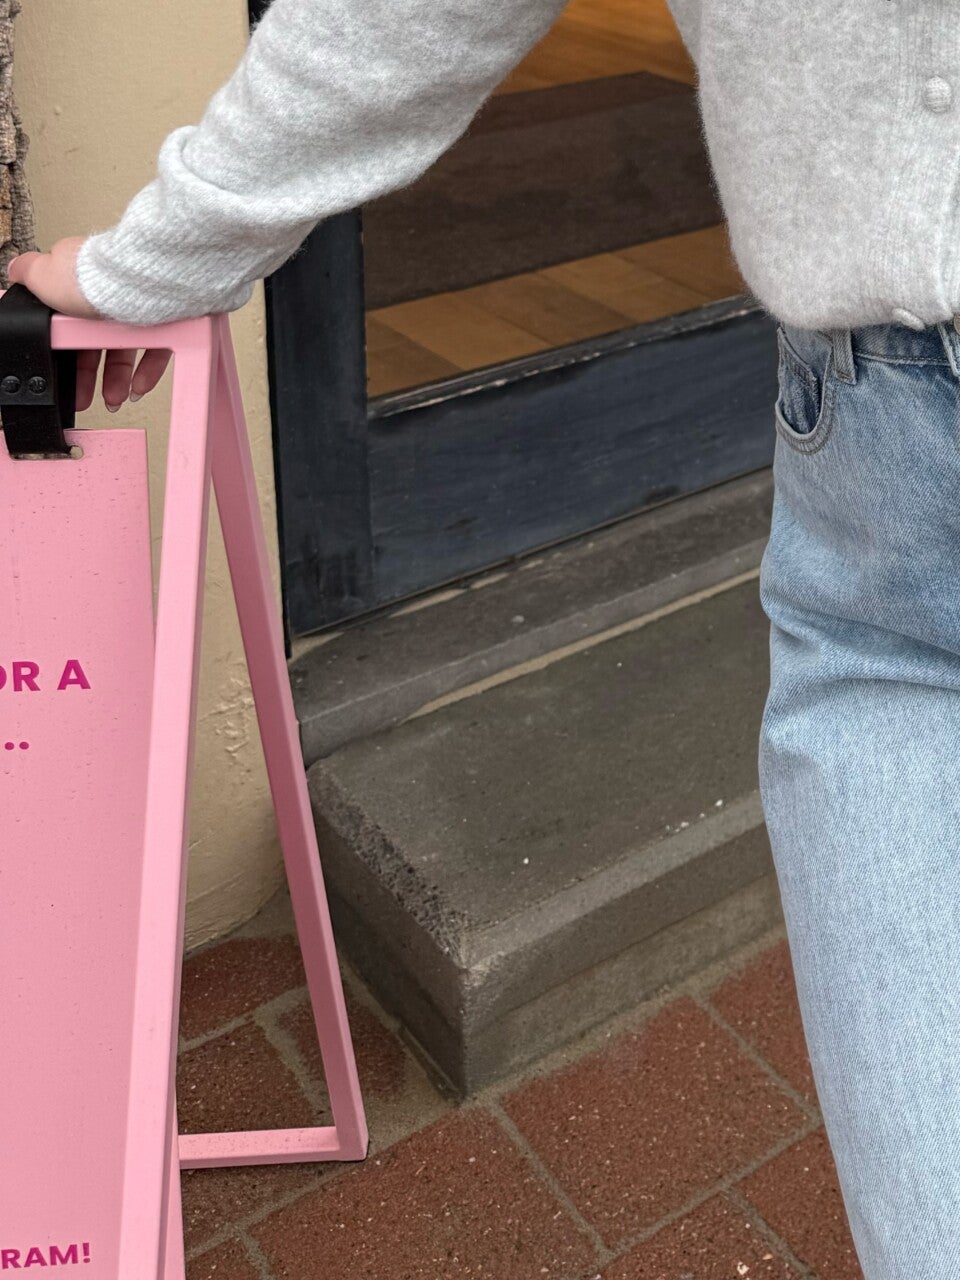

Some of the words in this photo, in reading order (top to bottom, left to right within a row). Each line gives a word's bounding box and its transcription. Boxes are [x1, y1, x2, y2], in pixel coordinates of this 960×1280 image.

[0, 661, 41, 692] R
[57, 659, 91, 691] A
[0, 1242, 91, 1270] RAM!
